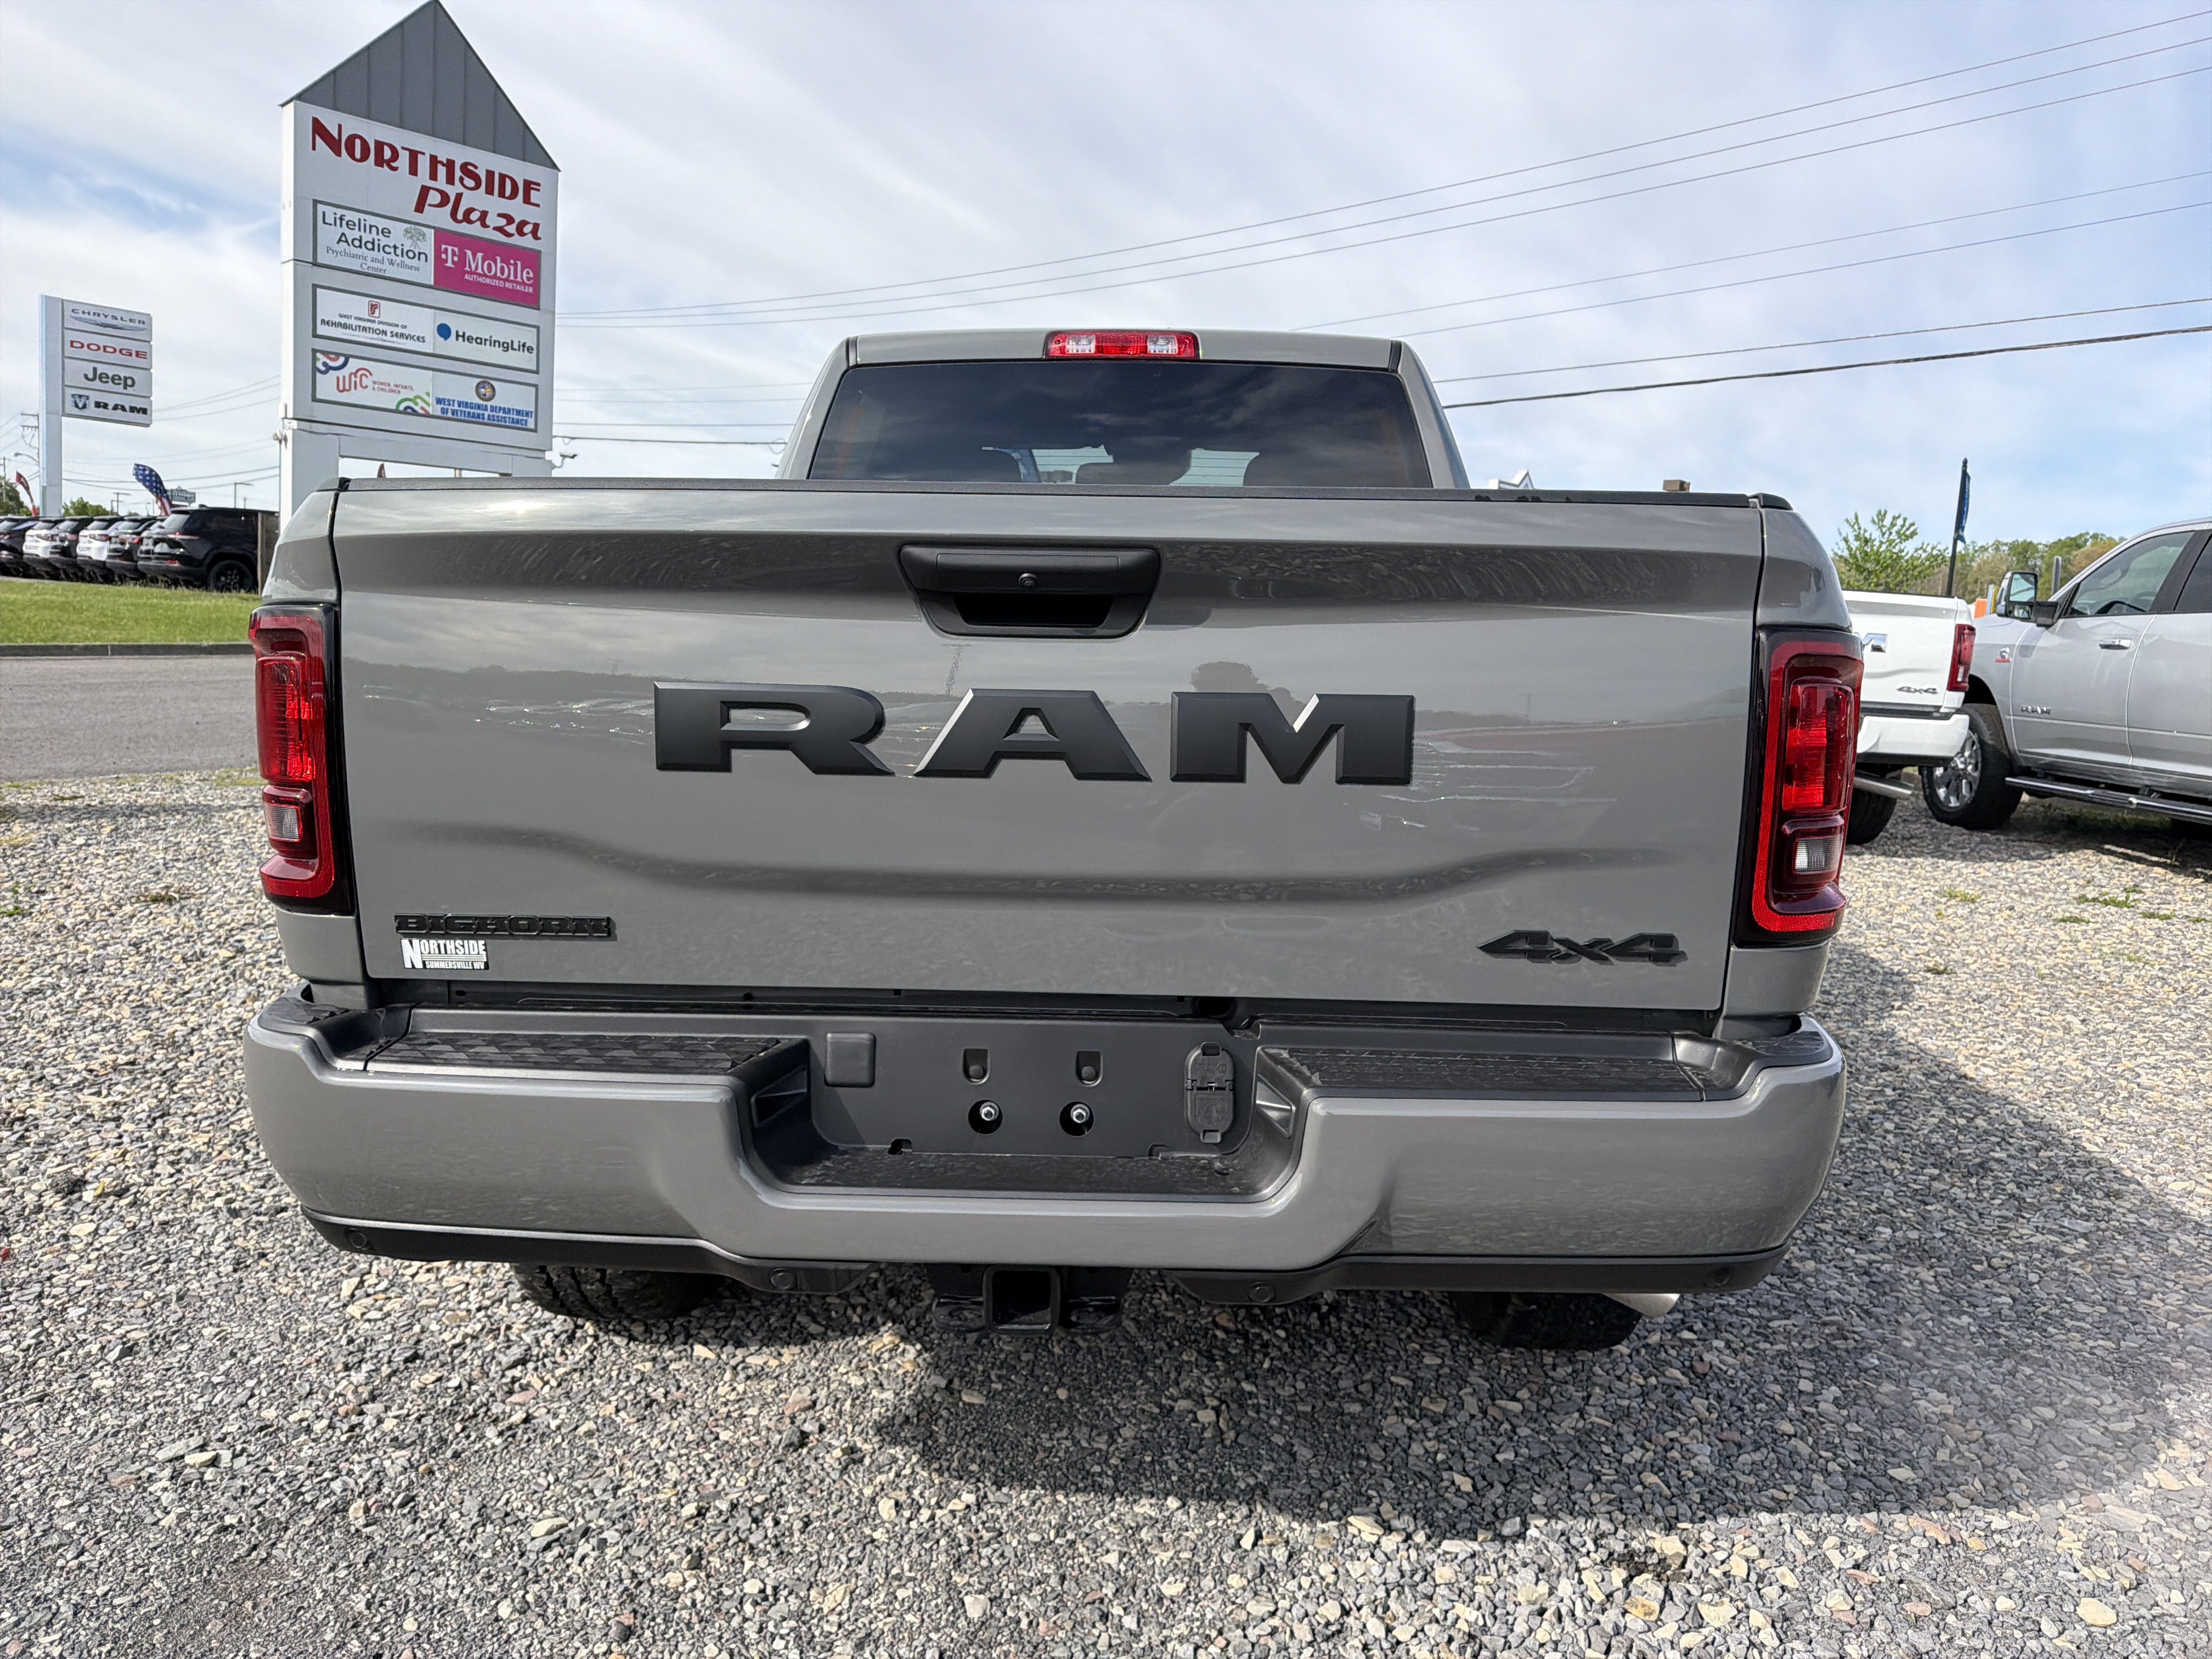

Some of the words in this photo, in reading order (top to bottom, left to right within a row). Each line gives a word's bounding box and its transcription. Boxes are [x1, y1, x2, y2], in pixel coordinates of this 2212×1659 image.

[312, 116, 541, 207] NORTHSIDE
[413, 184, 542, 240] Plaza
[322, 211, 392, 238] Lifeline
[326, 246, 368, 262] Psychiatric
[387, 258, 420, 272] Wellness
[336, 232, 428, 263] Addiction
[360, 262, 386, 274] Center
[441, 244, 458, 268] T
[464, 250, 533, 284] Mobile
[464, 274, 504, 288] AUTHORIZED
[505, 281, 533, 294] RETAILER
[71, 308, 145, 325] CHRYSLER
[320, 318, 387, 337] REHABILITATION
[390, 330, 426, 343] SERVICES
[455, 330, 534, 354] HearingLife
[70, 340, 148, 359] DODGE
[83, 366, 136, 390] Jeep
[377, 386, 401, 394] CHILDREN
[94, 400, 148, 415] RAM
[435, 396, 456, 407] WEST
[456, 399, 488, 411] VIRGINIA
[489, 404, 534, 419] DEPARTMENT
[441, 407, 449, 415] OF
[450, 408, 486, 421] VETERANS
[487, 414, 528, 427] ASSISTANCE
[654, 681, 1415, 785] RAM
[401, 939, 486, 968] NORTHSIDE
[1476, 930, 1686, 966] 4x4
[426, 961, 473, 969] SUMMERSVILLE
[473, 961, 485, 969] WV
